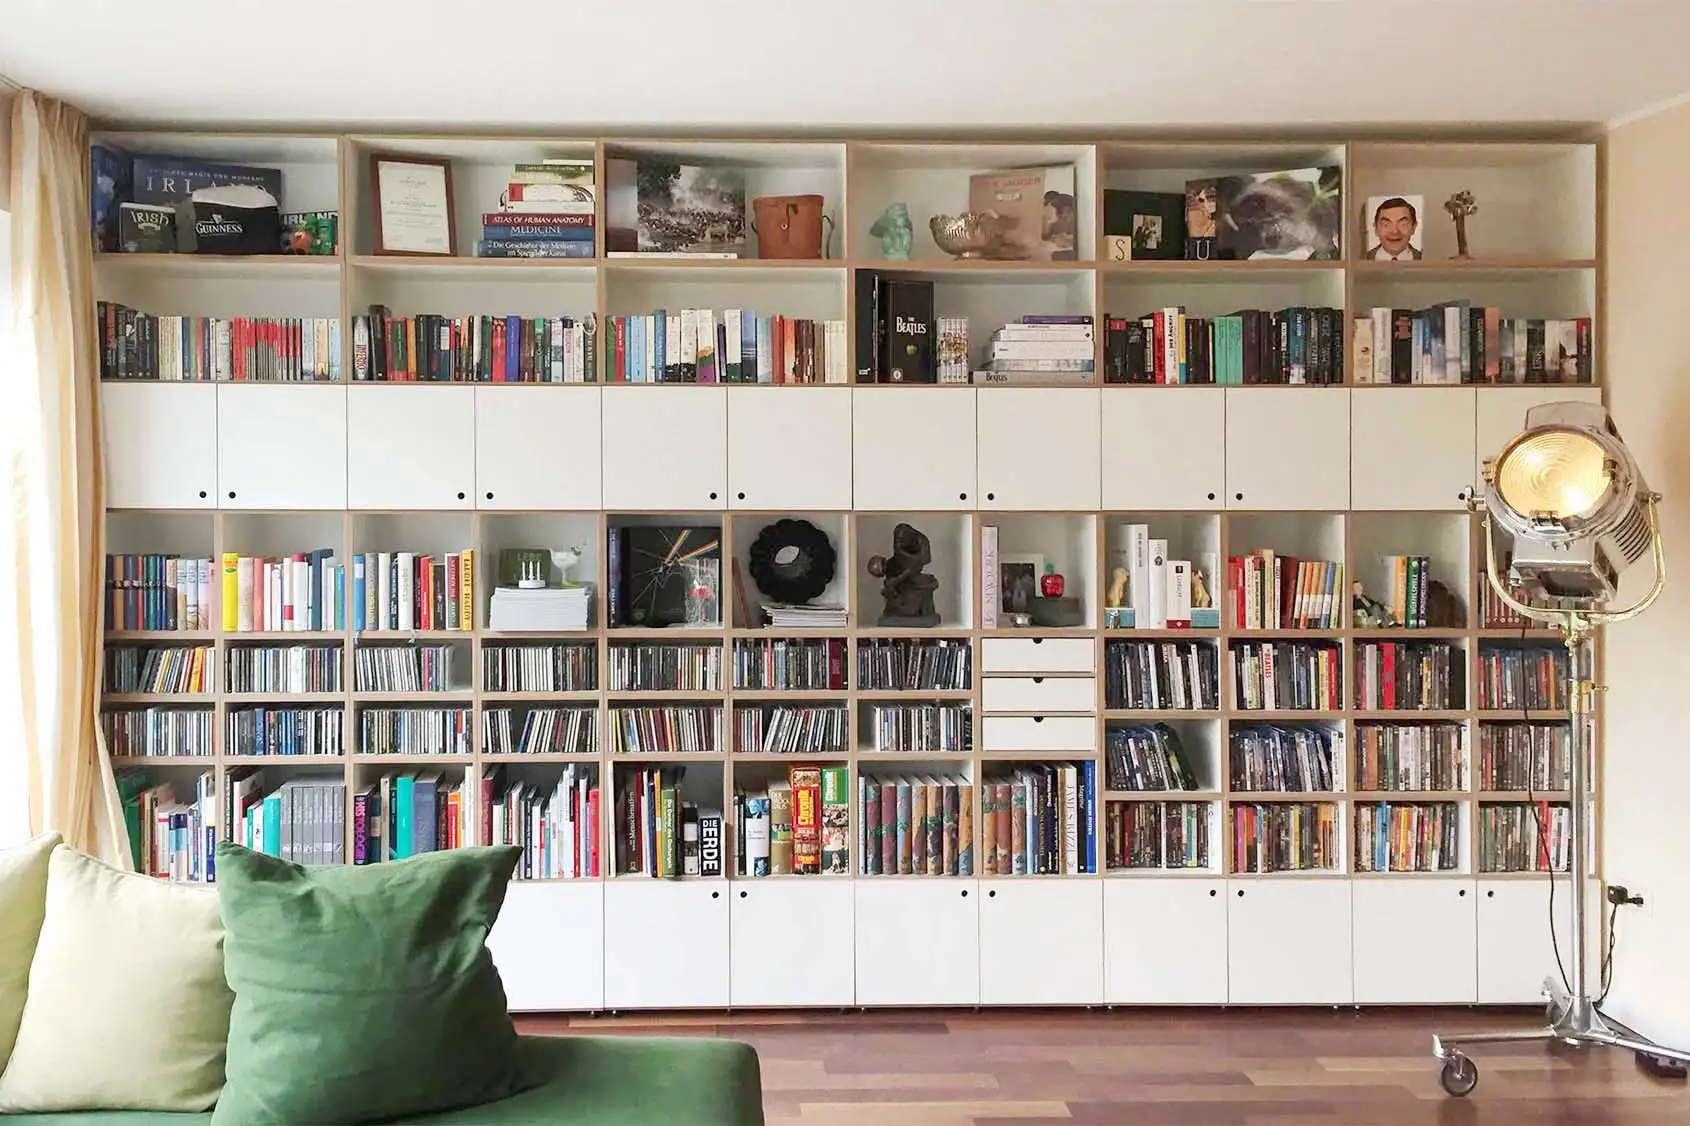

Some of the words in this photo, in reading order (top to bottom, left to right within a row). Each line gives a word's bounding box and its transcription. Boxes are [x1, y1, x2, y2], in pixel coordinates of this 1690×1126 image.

[195, 222, 243, 234] GUINNESS
[492, 215, 512, 224] ATLAS
[513, 216, 523, 224] OF
[524, 216, 551, 224] HUMAN
[551, 215, 585, 224] ANATOMY
[1115, 238, 1126, 261] S
[1196, 239, 1210, 260] U
[984, 550, 995, 580] YORK
[984, 581, 995, 603] NEW
[463, 591, 471, 622] HARDY
[1263, 652, 1272, 679] BEATLES
[798, 789, 809, 826] Chronik
[1066, 784, 1077, 820] JAMES
[354, 801, 366, 860] HISTOLOGIE
[702, 819, 718, 828] DIE
[702, 828, 718, 871] ERDE
[1066, 823, 1077, 853] RIZZI
